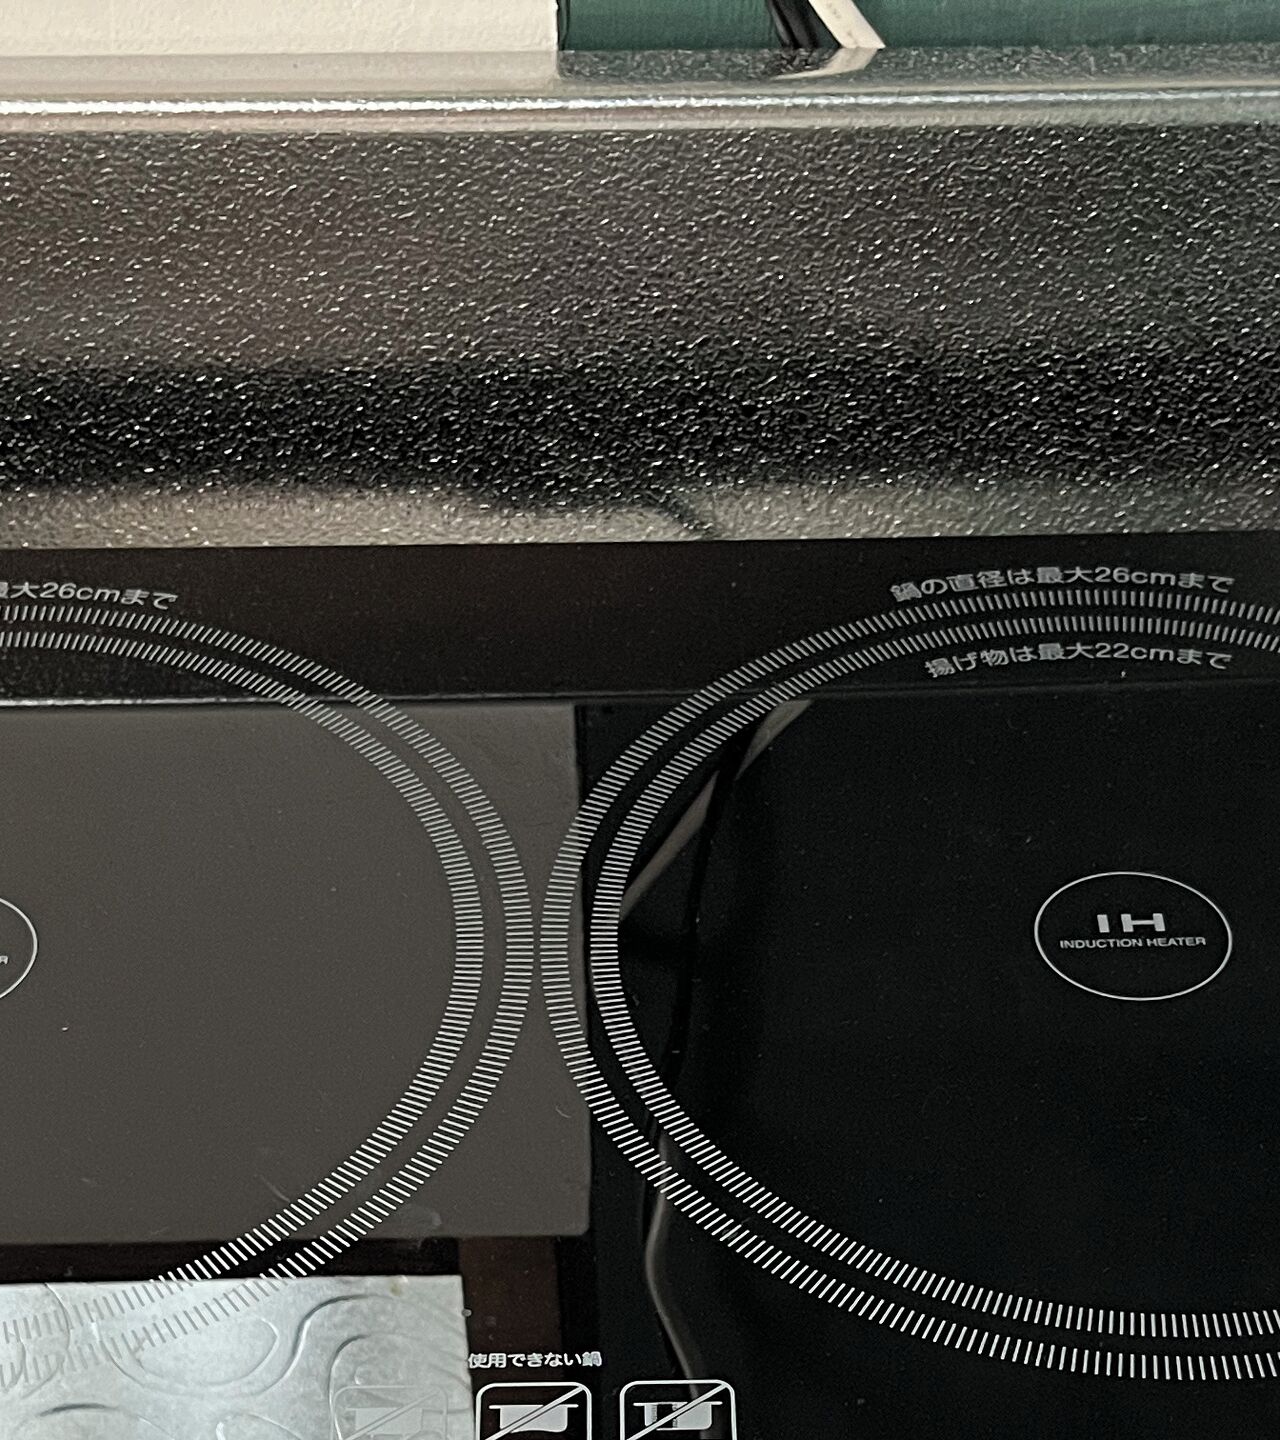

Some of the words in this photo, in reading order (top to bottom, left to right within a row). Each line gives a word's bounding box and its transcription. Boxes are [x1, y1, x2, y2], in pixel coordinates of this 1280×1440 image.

[889, 566, 1235, 602] 鍋の直径は最大26cmまで
[925, 642, 1232, 678] 揚げ物は最大22cmまで
[1097, 913, 1166, 933] IH
[1060, 938, 1143, 949] INDUCTION
[1146, 937, 1207, 947] HEATER
[468, 1350, 602, 1368] 使用できない鍋
